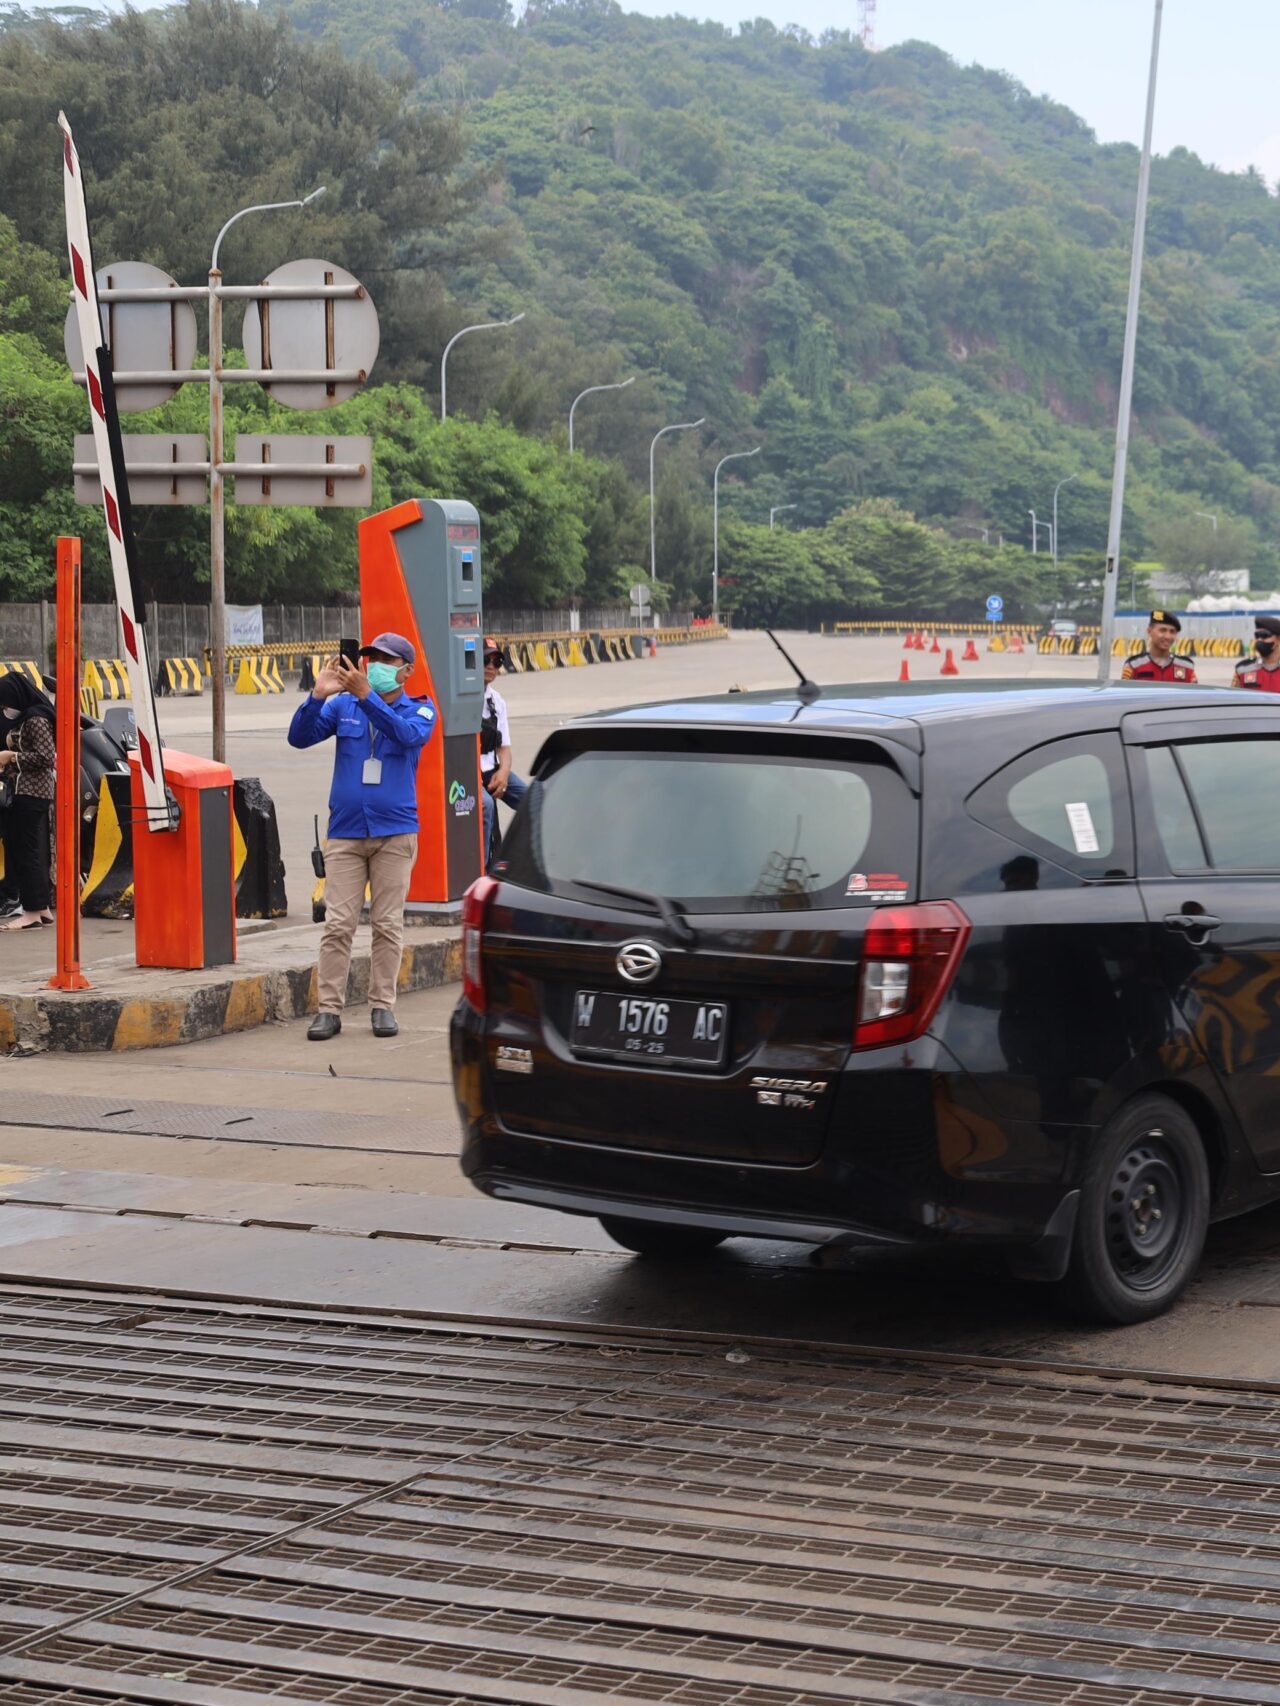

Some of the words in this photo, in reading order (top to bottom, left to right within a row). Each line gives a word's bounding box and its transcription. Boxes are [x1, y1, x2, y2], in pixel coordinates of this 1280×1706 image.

[577, 994, 595, 1027] W
[618, 999, 670, 1035] 1576
[692, 1006, 723, 1041] AC
[749, 1076, 828, 1094] SIGRA
